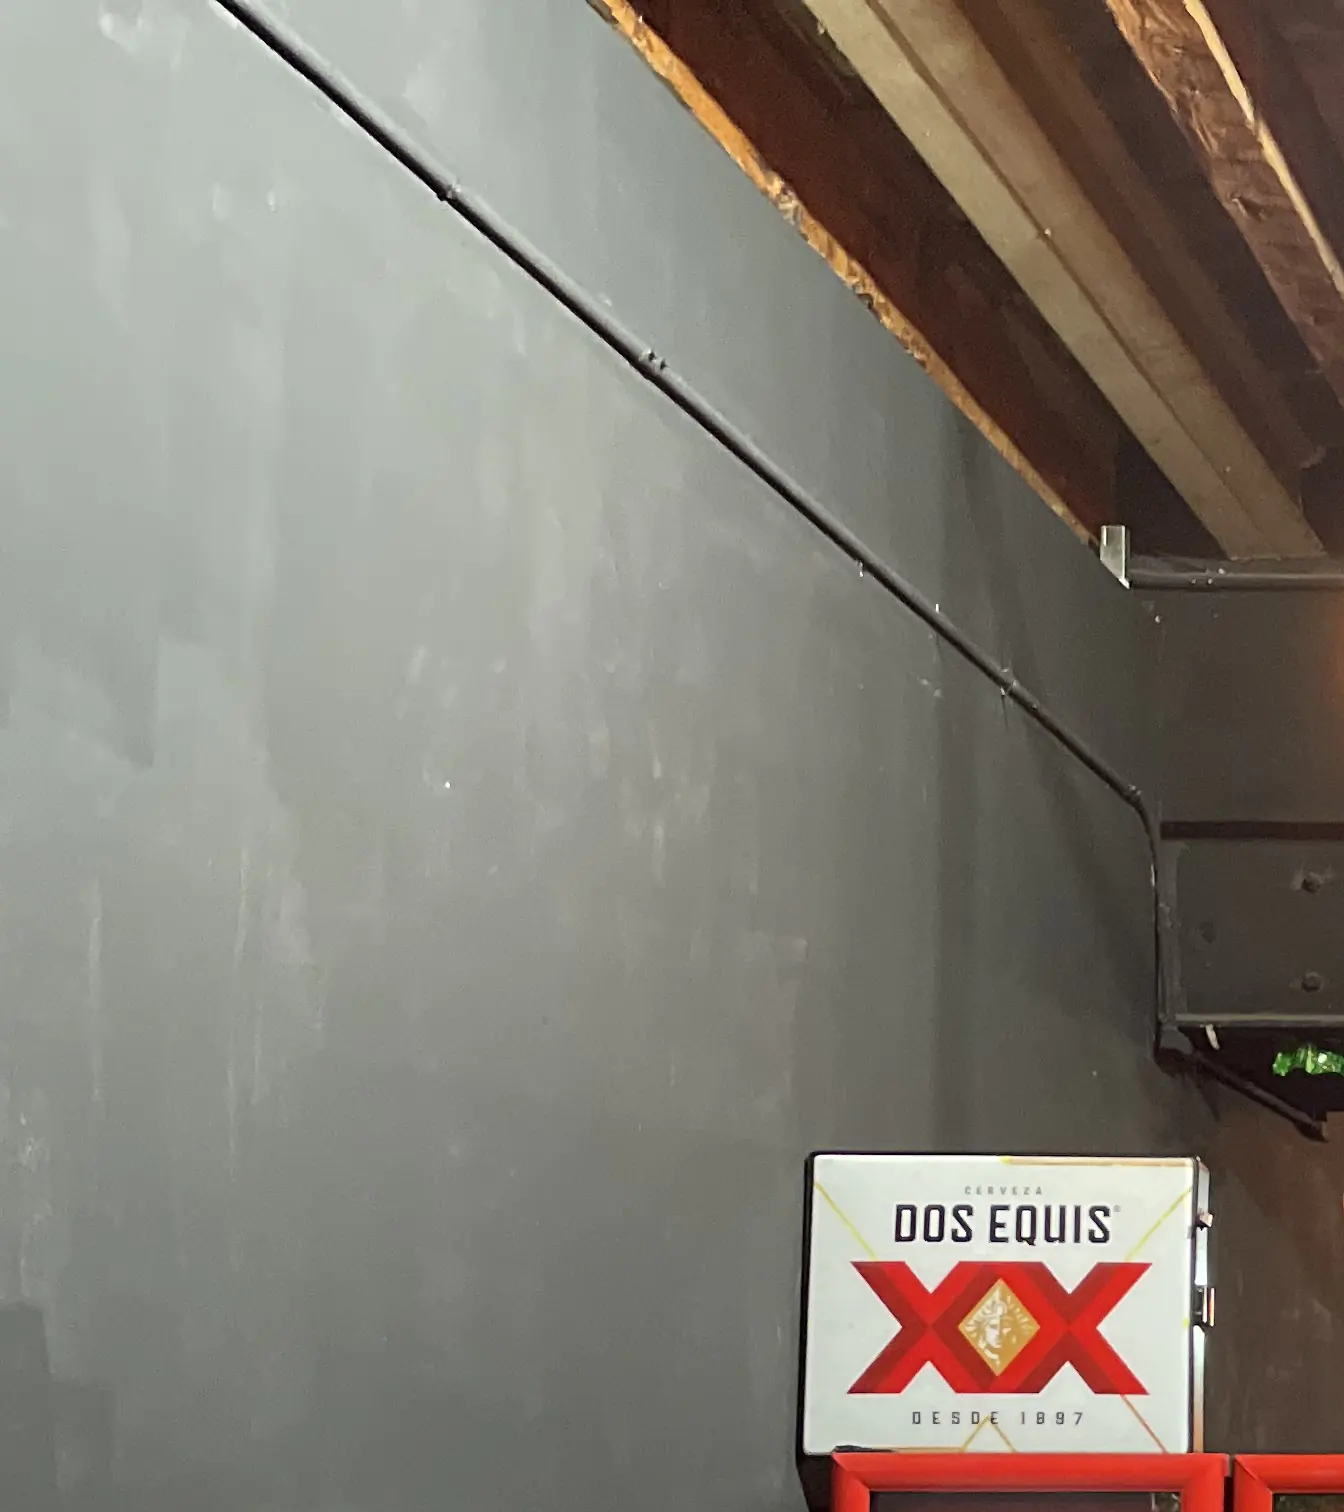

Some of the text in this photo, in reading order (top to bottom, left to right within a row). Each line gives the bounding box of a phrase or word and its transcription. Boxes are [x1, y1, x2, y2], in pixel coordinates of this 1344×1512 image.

[964, 1186, 1043, 1196] CERVEZA
[894, 1204, 1111, 1247] DOS EQUIS
[847, 1261, 1153, 1396] XX
[912, 1411, 1084, 1425] DESDE 1897
